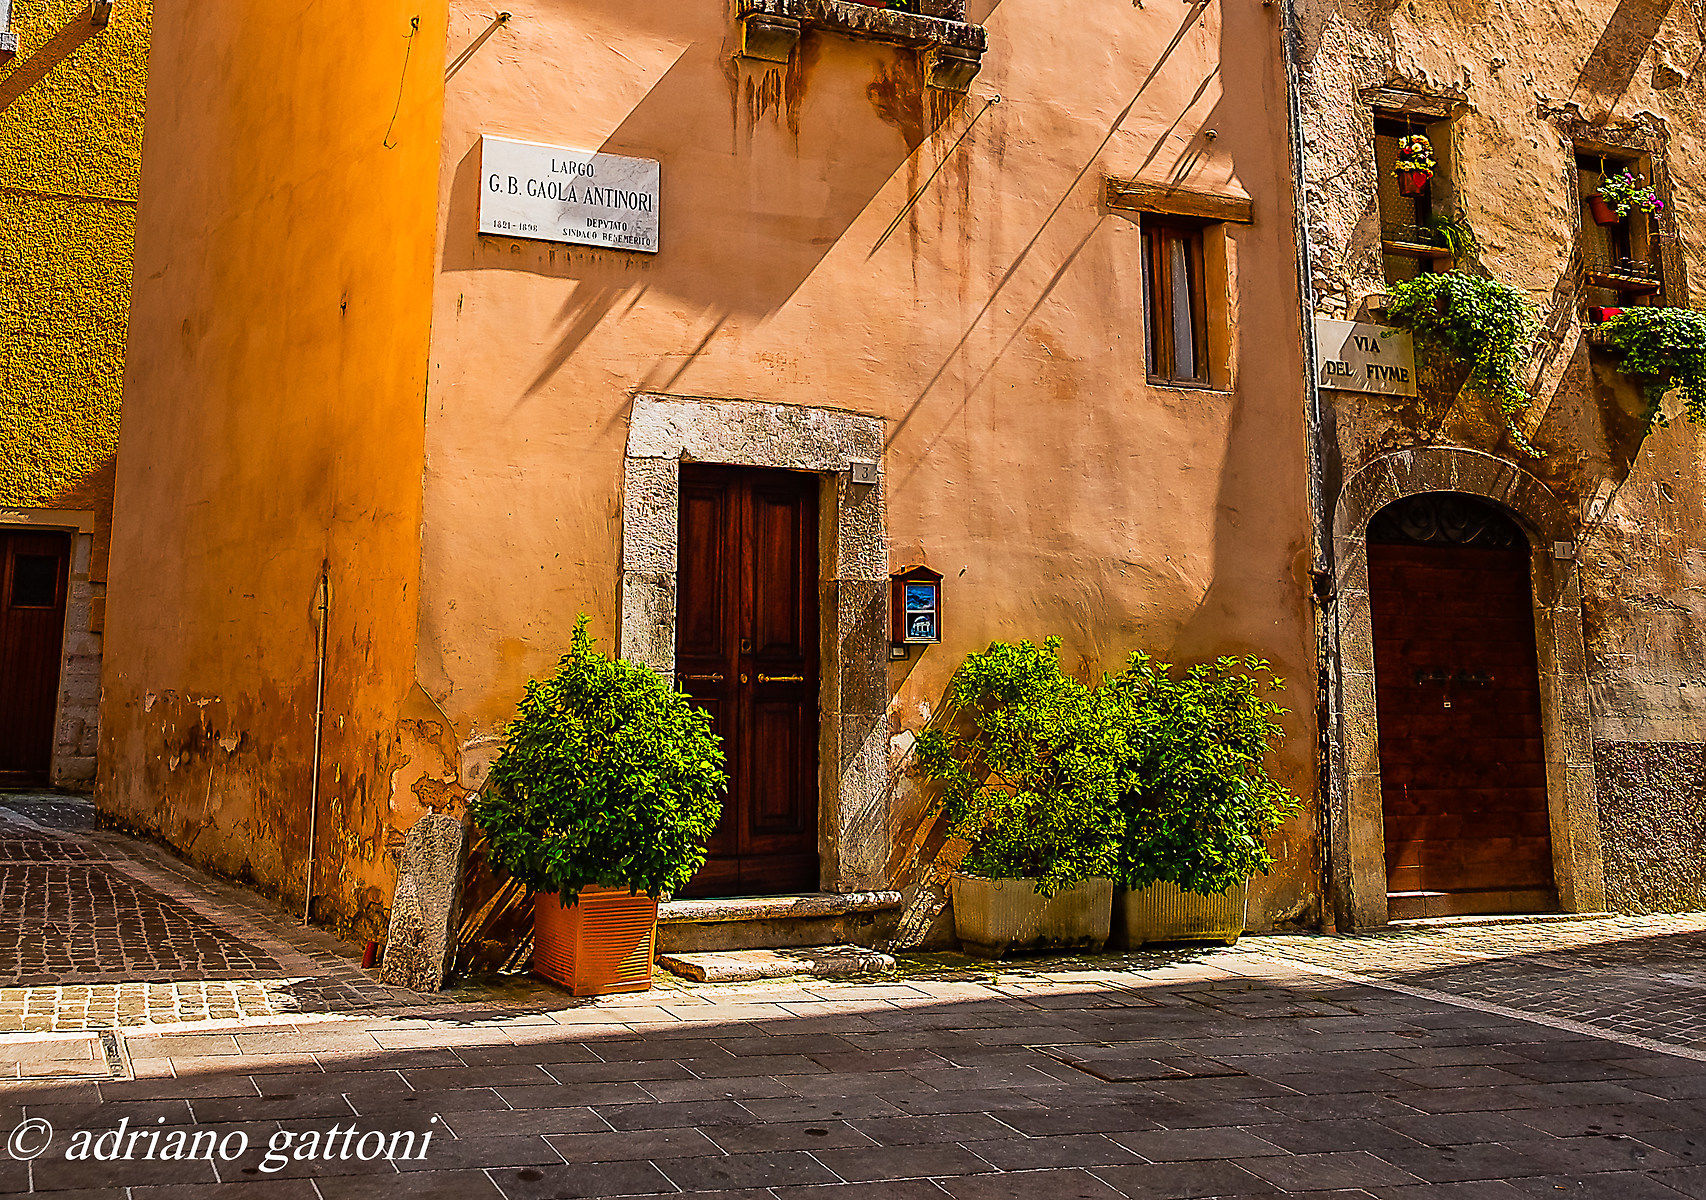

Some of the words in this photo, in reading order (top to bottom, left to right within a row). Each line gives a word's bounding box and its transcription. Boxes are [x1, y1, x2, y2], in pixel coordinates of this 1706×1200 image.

[551, 158, 594, 178] LARGO
[489, 173, 503, 193] G.
[508, 176, 522, 196] B.
[527, 178, 578, 203] GAOLA
[583, 186, 652, 212] ANTINORI
[586, 217, 628, 231] DEPVTATO
[562, 227, 597, 239] SINDACO
[602, 232, 651, 246] BENEMERITO
[1353, 335, 1380, 353] VIA
[1326, 360, 1354, 377] DEL
[1366, 363, 1409, 383] FIVME
[861, 466, 869, 479] 3
